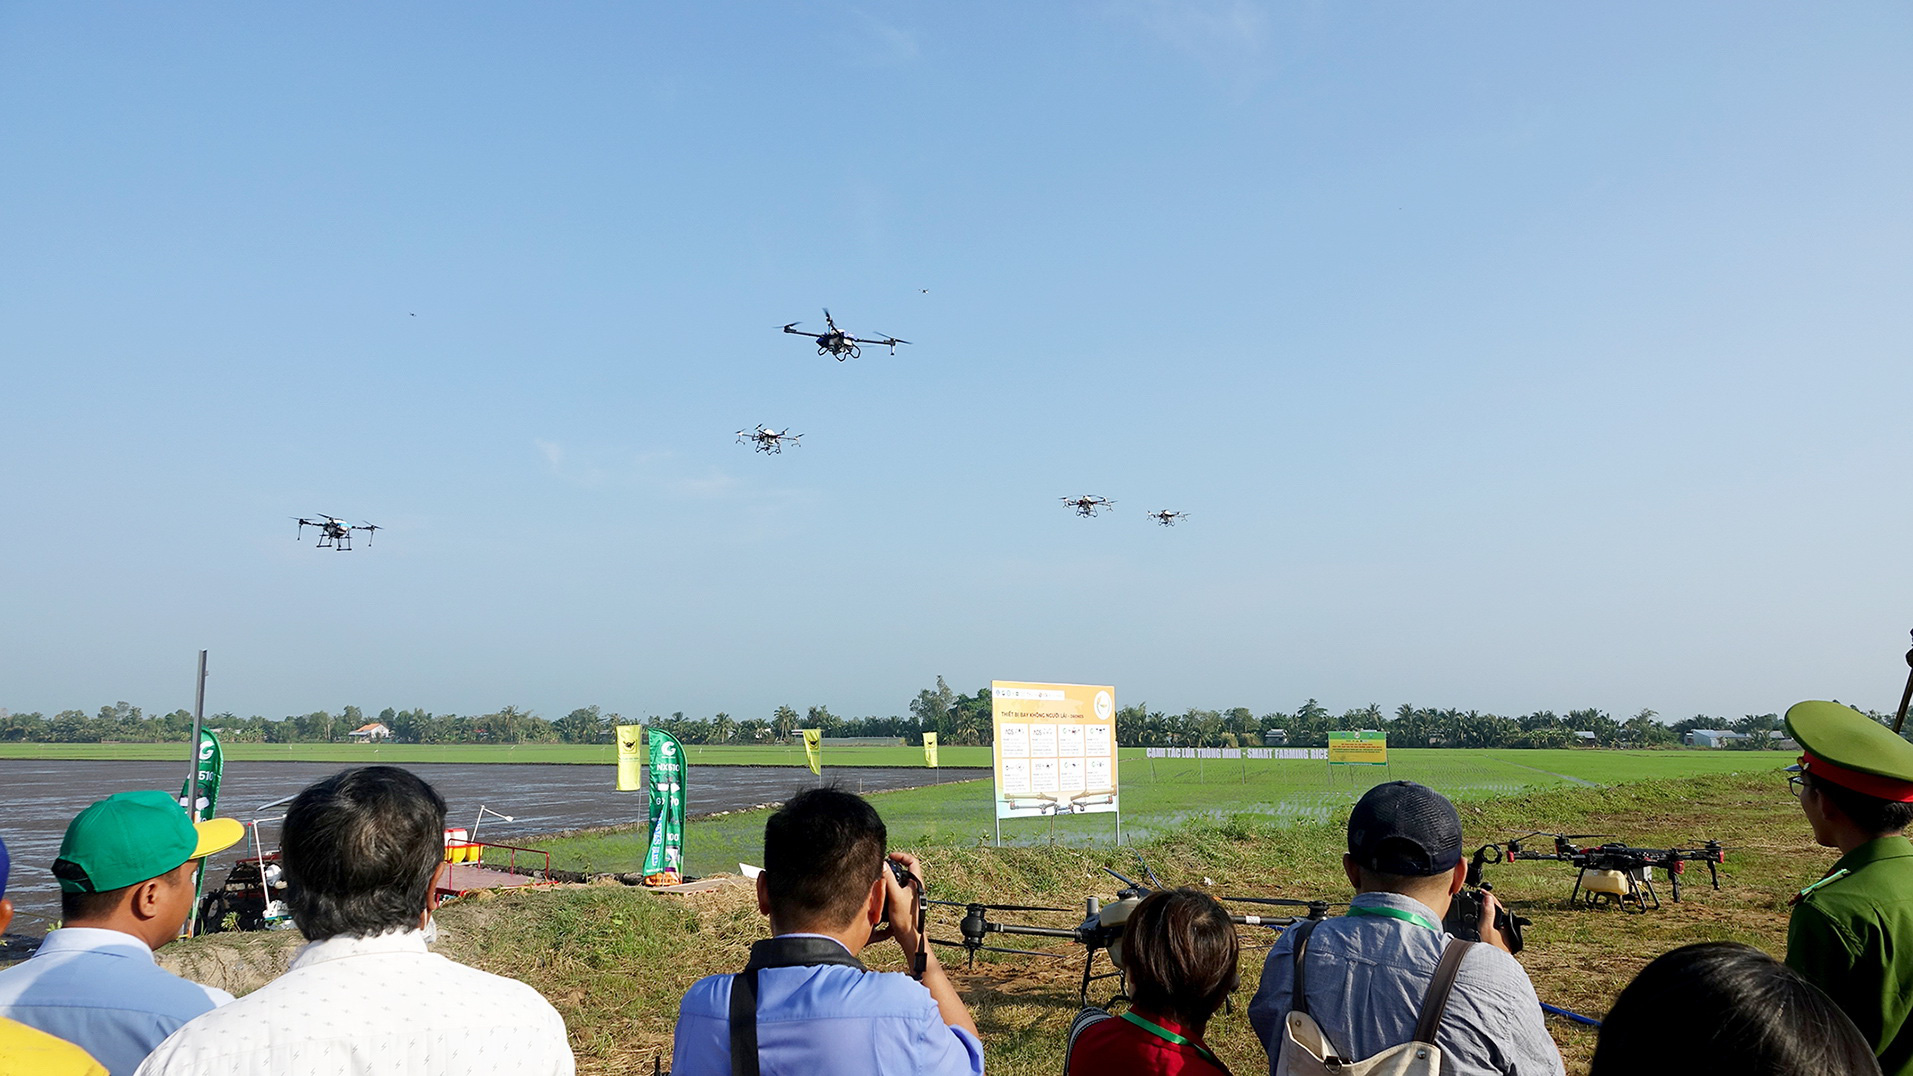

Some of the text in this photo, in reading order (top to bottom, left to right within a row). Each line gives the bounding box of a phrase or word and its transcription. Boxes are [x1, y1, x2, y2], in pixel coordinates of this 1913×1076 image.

[1029, 711, 1045, 719] KHÔNG
[1197, 745, 1221, 759] THÔNG
[1222, 747, 1241, 759] MINH
[1247, 747, 1273, 759] SMART
[1275, 748, 1309, 760] FARMING
[1310, 748, 1328, 760] RICE
[656, 763, 679, 772] NX510
